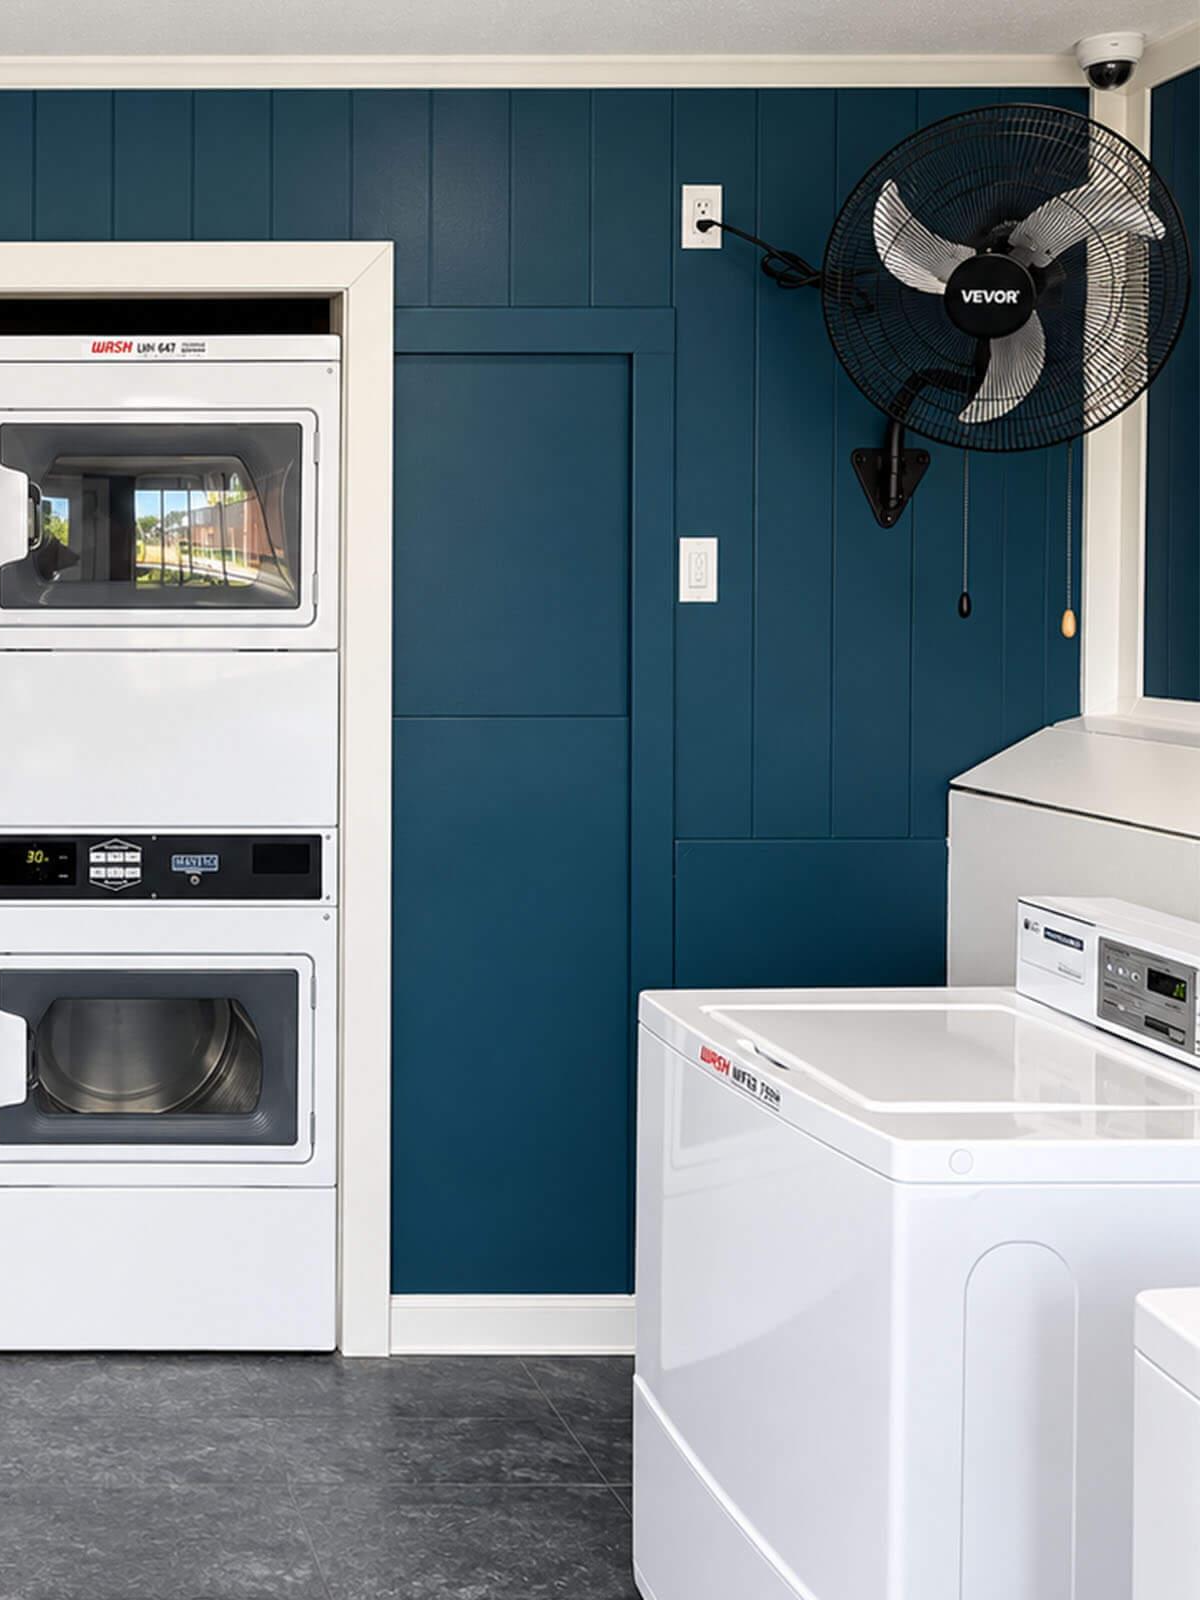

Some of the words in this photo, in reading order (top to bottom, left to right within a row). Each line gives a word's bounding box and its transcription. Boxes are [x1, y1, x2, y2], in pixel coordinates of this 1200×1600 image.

[961, 289, 1019, 305] VEVOR
[91, 340, 134, 353] WASH
[26, 849, 44, 864] 30
